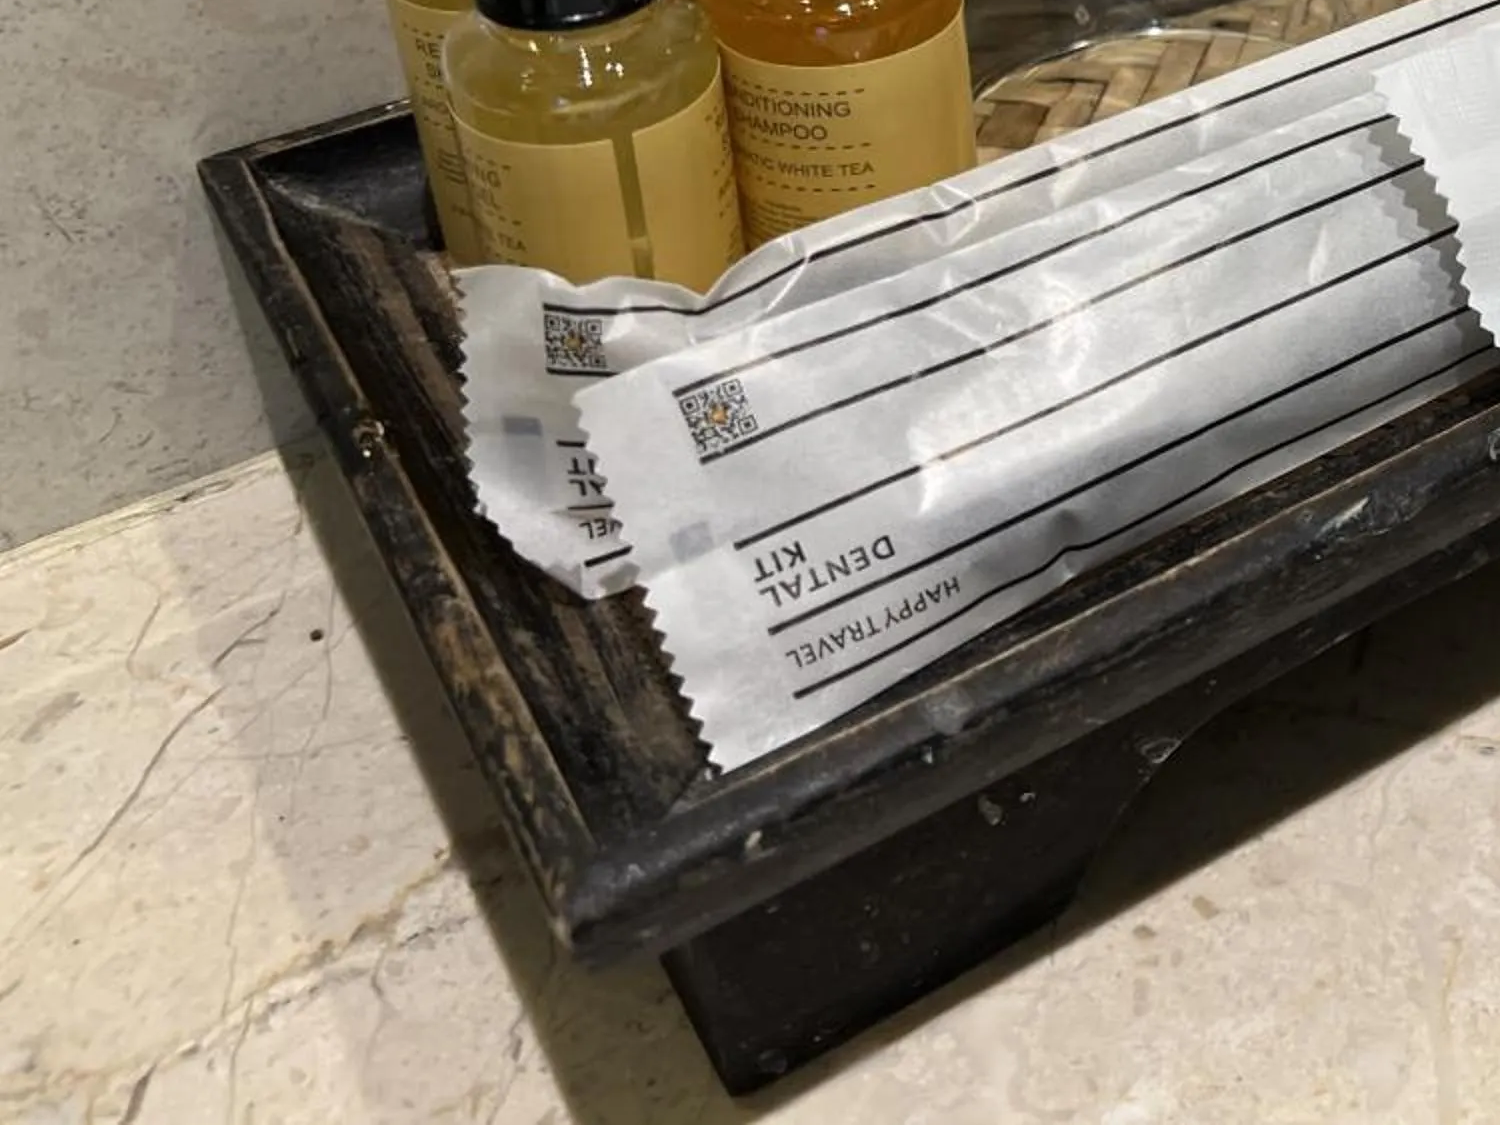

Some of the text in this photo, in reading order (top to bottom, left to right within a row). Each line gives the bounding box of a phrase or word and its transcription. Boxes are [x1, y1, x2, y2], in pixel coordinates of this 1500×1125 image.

[734, 86, 851, 118] DITIONING
[777, 160, 835, 178] WHITE
[836, 161, 874, 178] TEA
[754, 540, 807, 583] KIT
[759, 534, 896, 607] DENTAL
[785, 576, 961, 668] HAPPY TRAVEL
